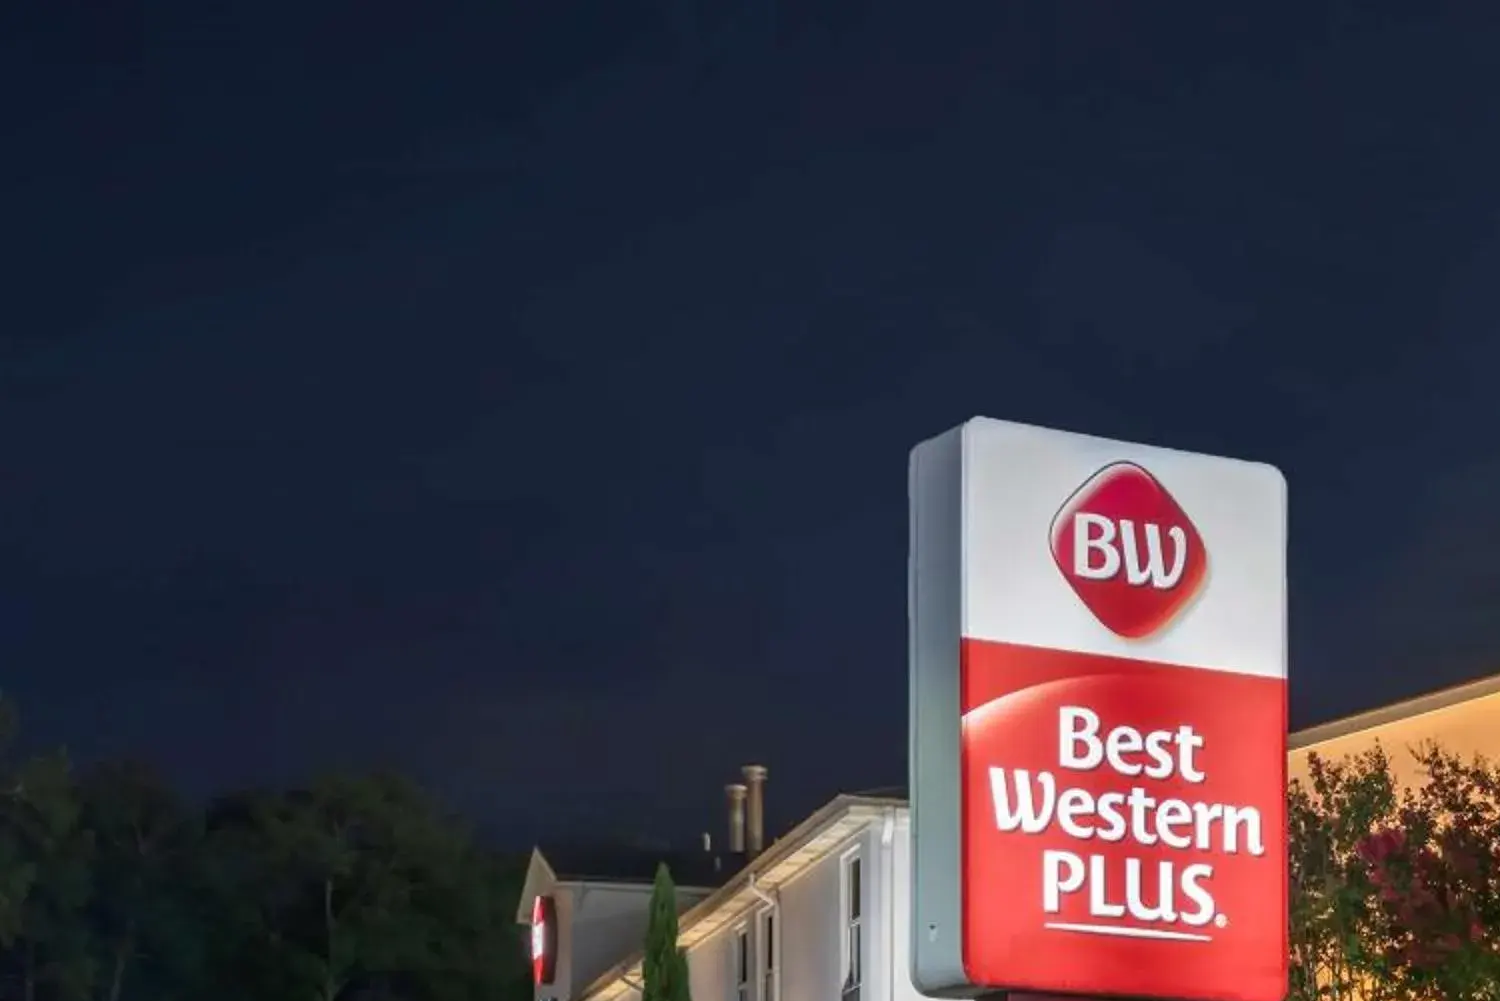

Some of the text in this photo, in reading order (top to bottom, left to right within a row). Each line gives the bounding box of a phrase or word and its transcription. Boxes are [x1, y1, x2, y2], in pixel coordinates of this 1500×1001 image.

[1073, 513, 1187, 589] BW
[1058, 705, 1203, 781] Best
[989, 767, 1264, 855] Western
